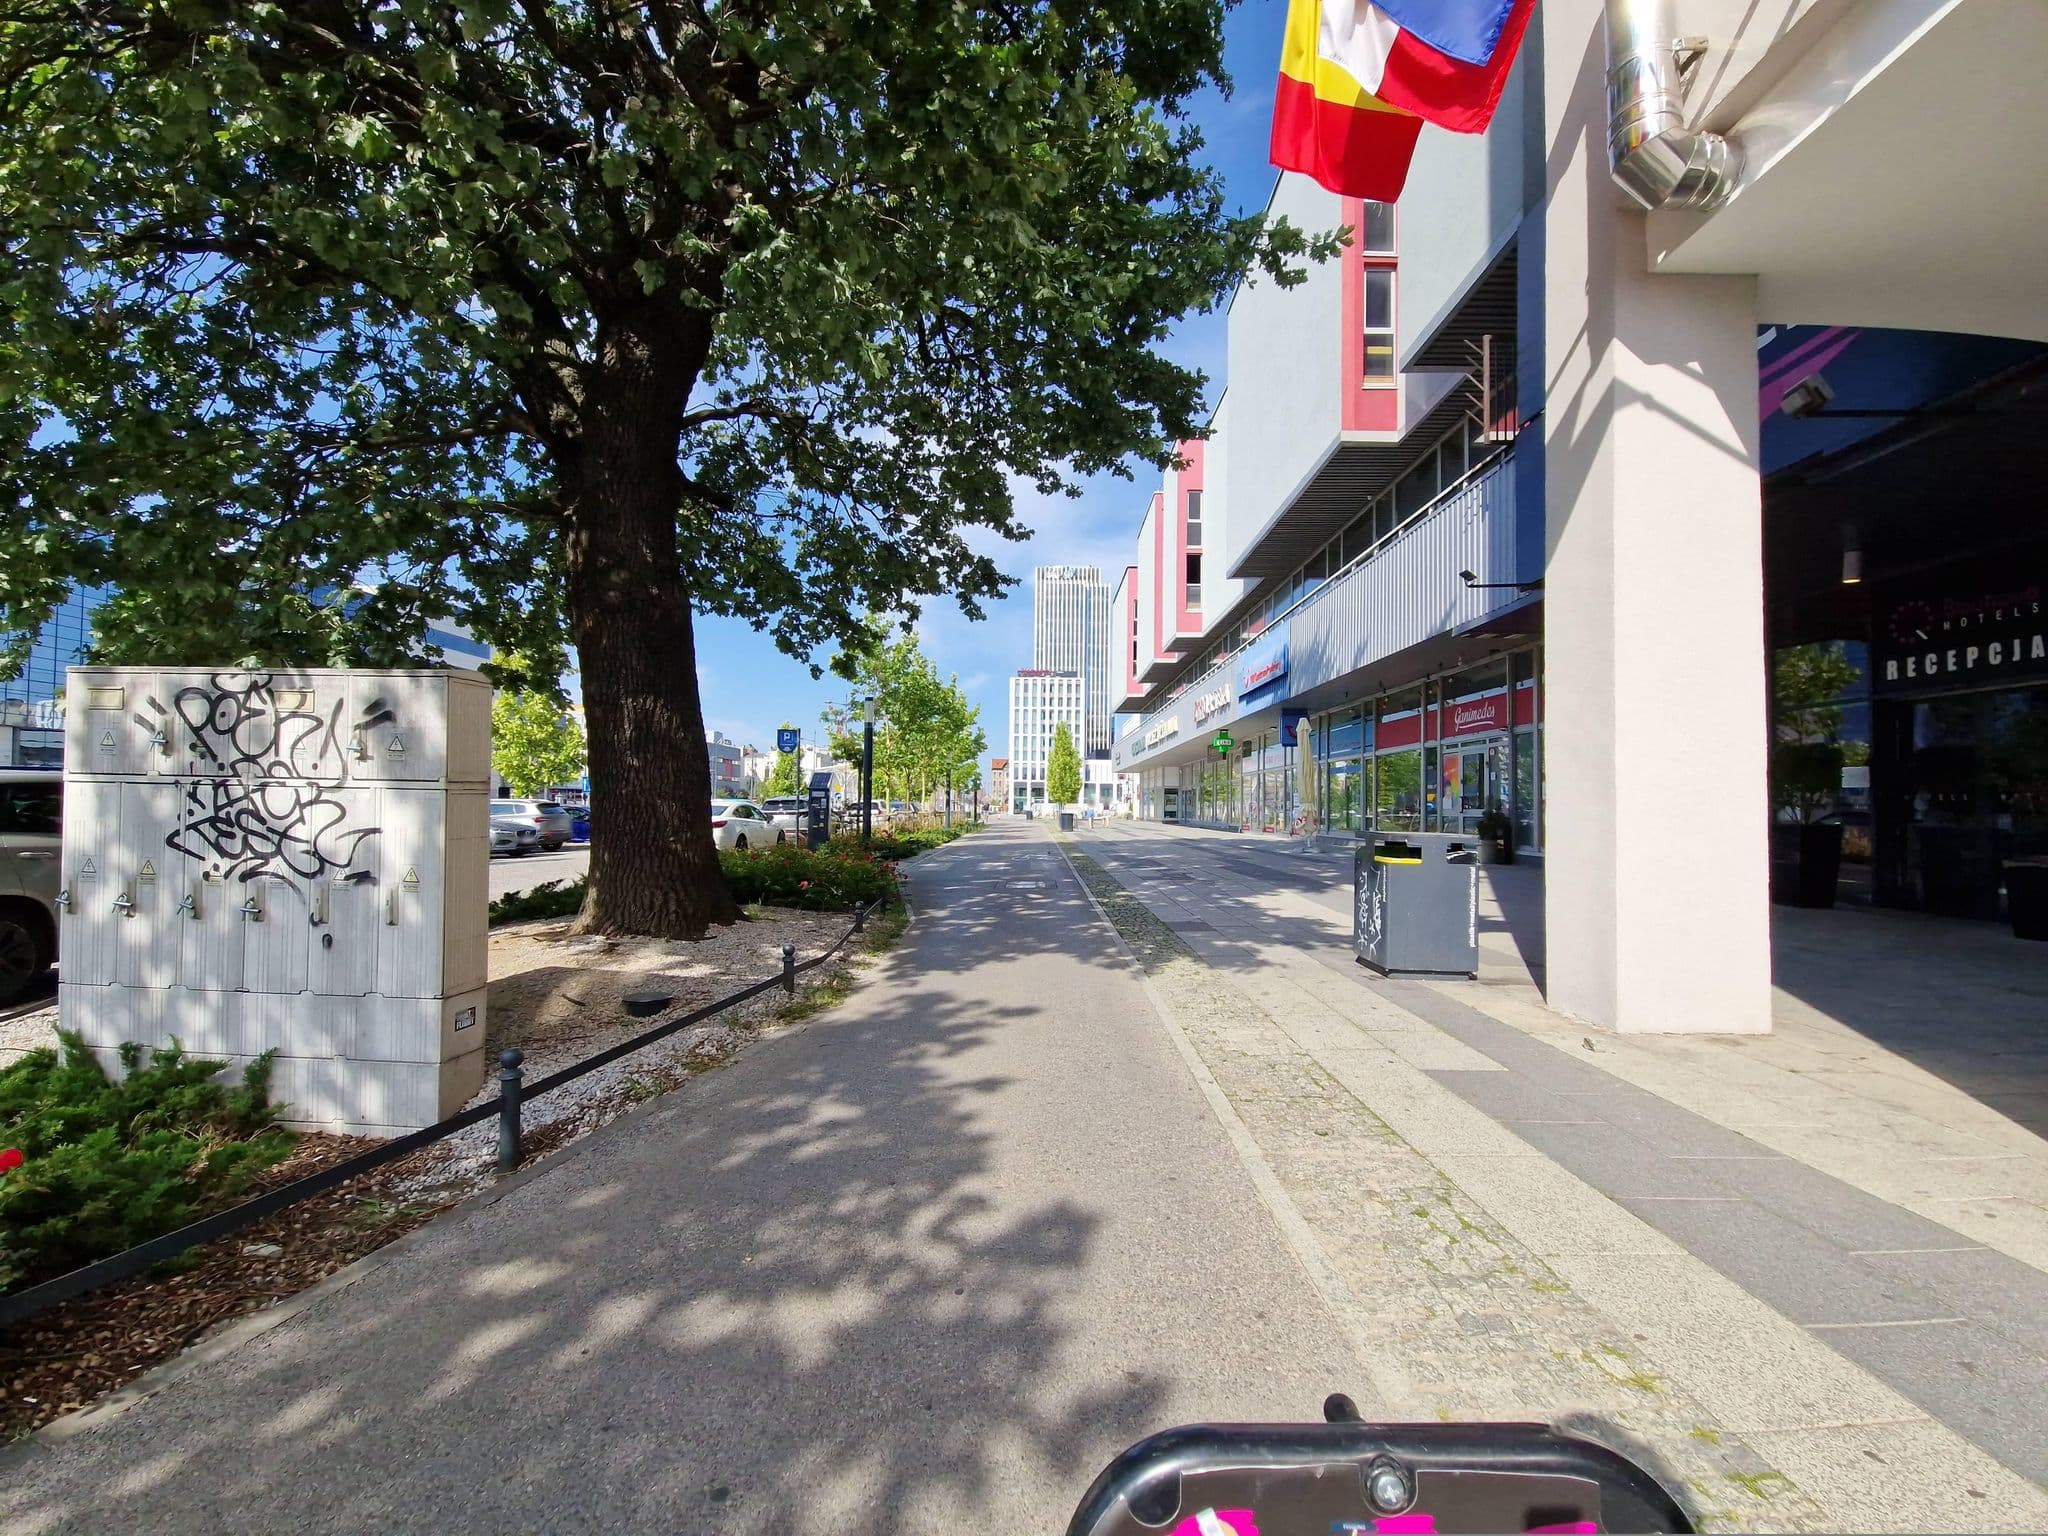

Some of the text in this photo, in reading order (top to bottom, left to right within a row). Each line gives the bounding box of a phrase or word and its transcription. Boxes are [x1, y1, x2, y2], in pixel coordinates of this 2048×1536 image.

[1943, 602, 2039, 631] HOTELS
[1886, 634, 2045, 681] RECEPCJA
[1454, 701, 1496, 732] Ganimedes
[783, 732, 791, 741] P
